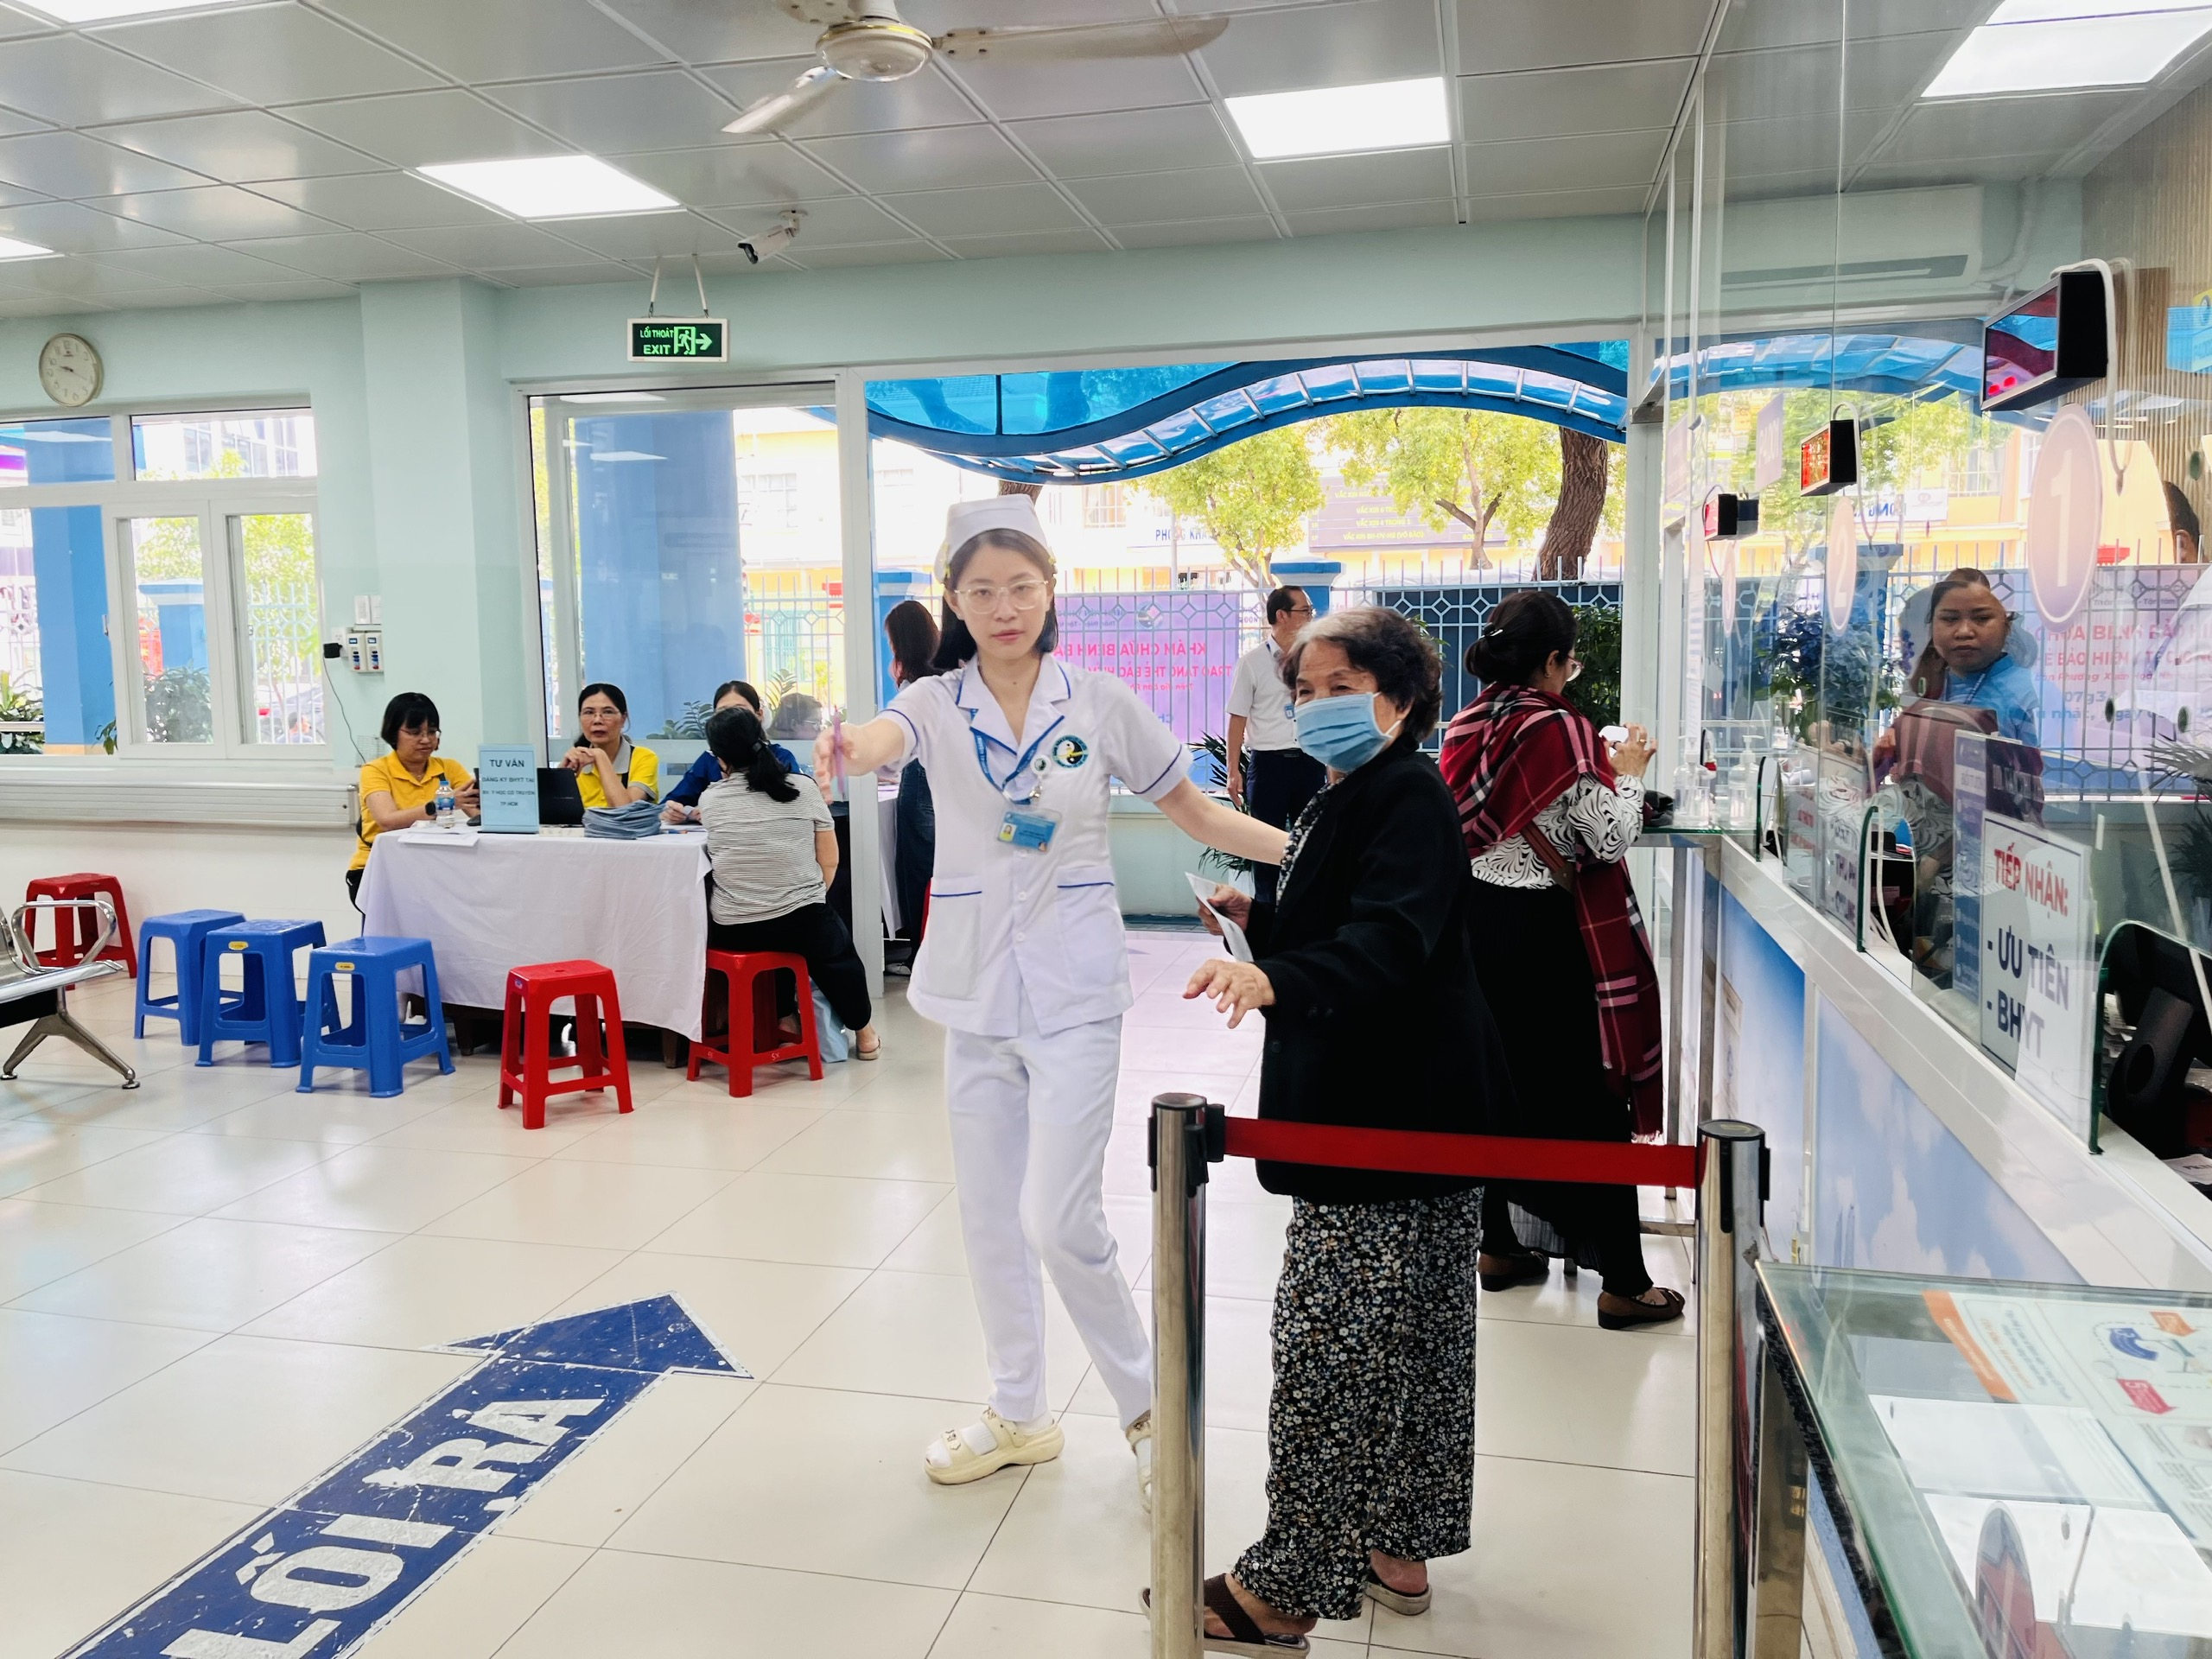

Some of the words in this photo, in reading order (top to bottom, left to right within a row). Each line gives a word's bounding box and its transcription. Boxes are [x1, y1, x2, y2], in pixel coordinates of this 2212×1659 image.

[643, 344, 671, 355] EXIT
[2050, 448, 2073, 588] 1
[1833, 525, 1848, 608] 2
[1993, 842, 2023, 892] TIẾP
[2024, 860, 2069, 918] NHẬN:
[1999, 925, 2023, 979] ƯU
[2027, 943, 2069, 1011] TIÊN
[1998, 988, 2045, 1058] BHYT
[410, 1397, 605, 1493] RA
